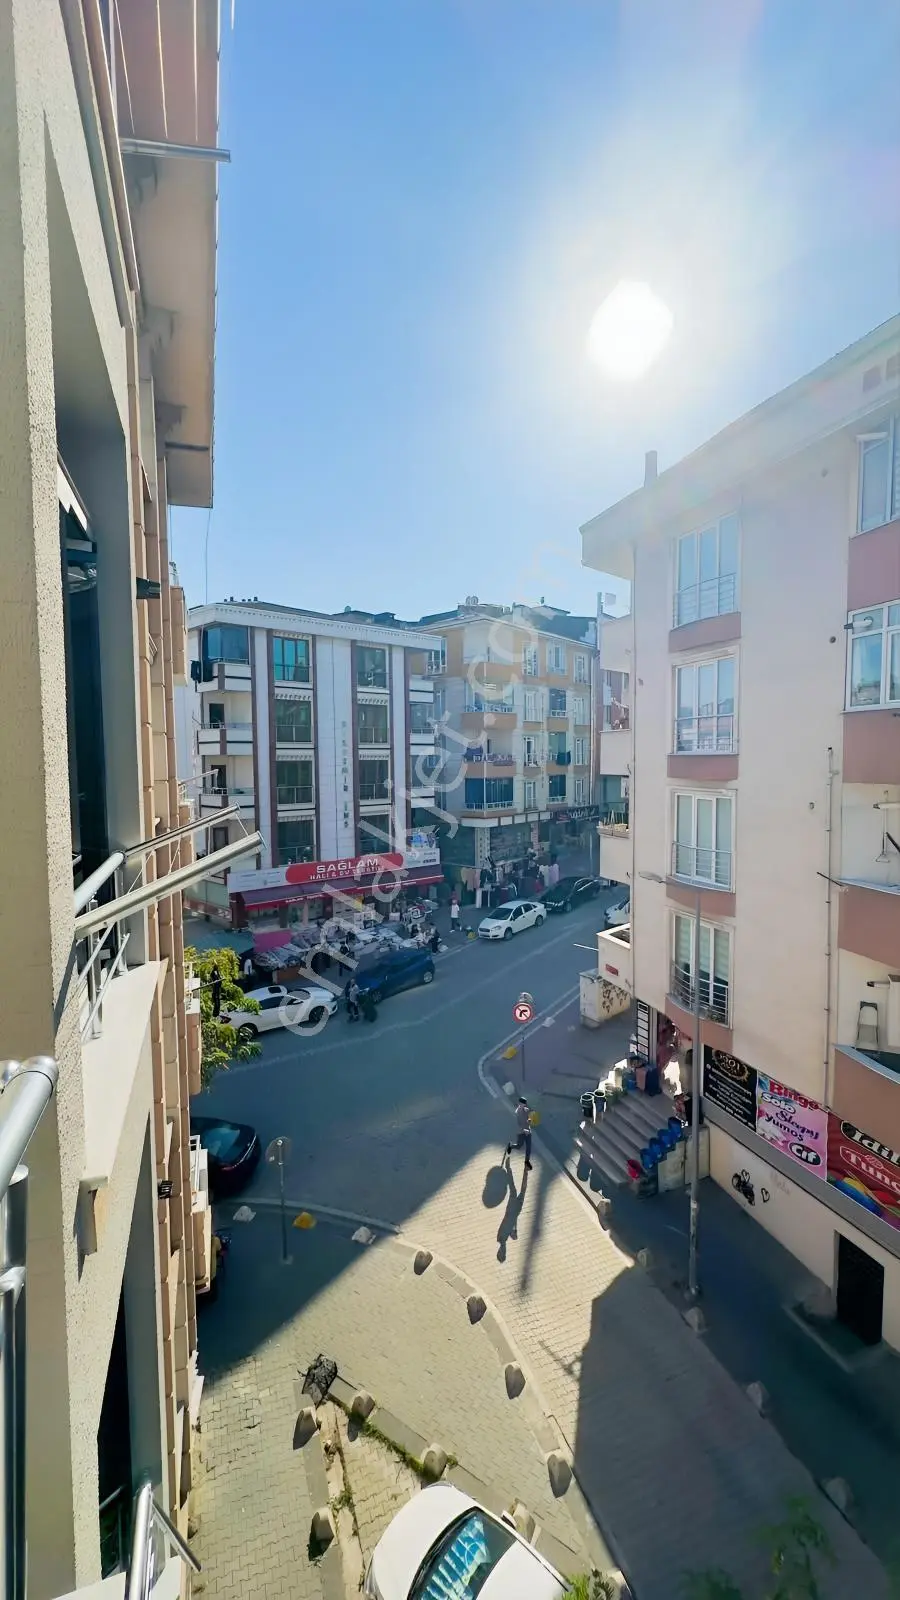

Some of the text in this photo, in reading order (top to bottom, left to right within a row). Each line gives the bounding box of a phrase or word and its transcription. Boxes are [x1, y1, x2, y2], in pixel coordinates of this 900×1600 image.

[316, 858, 379, 874] SAĞLAM
[762, 1091, 796, 1115] Solo
[769, 1080, 819, 1110] Bingo
[791, 1145, 818, 1163] Cif
